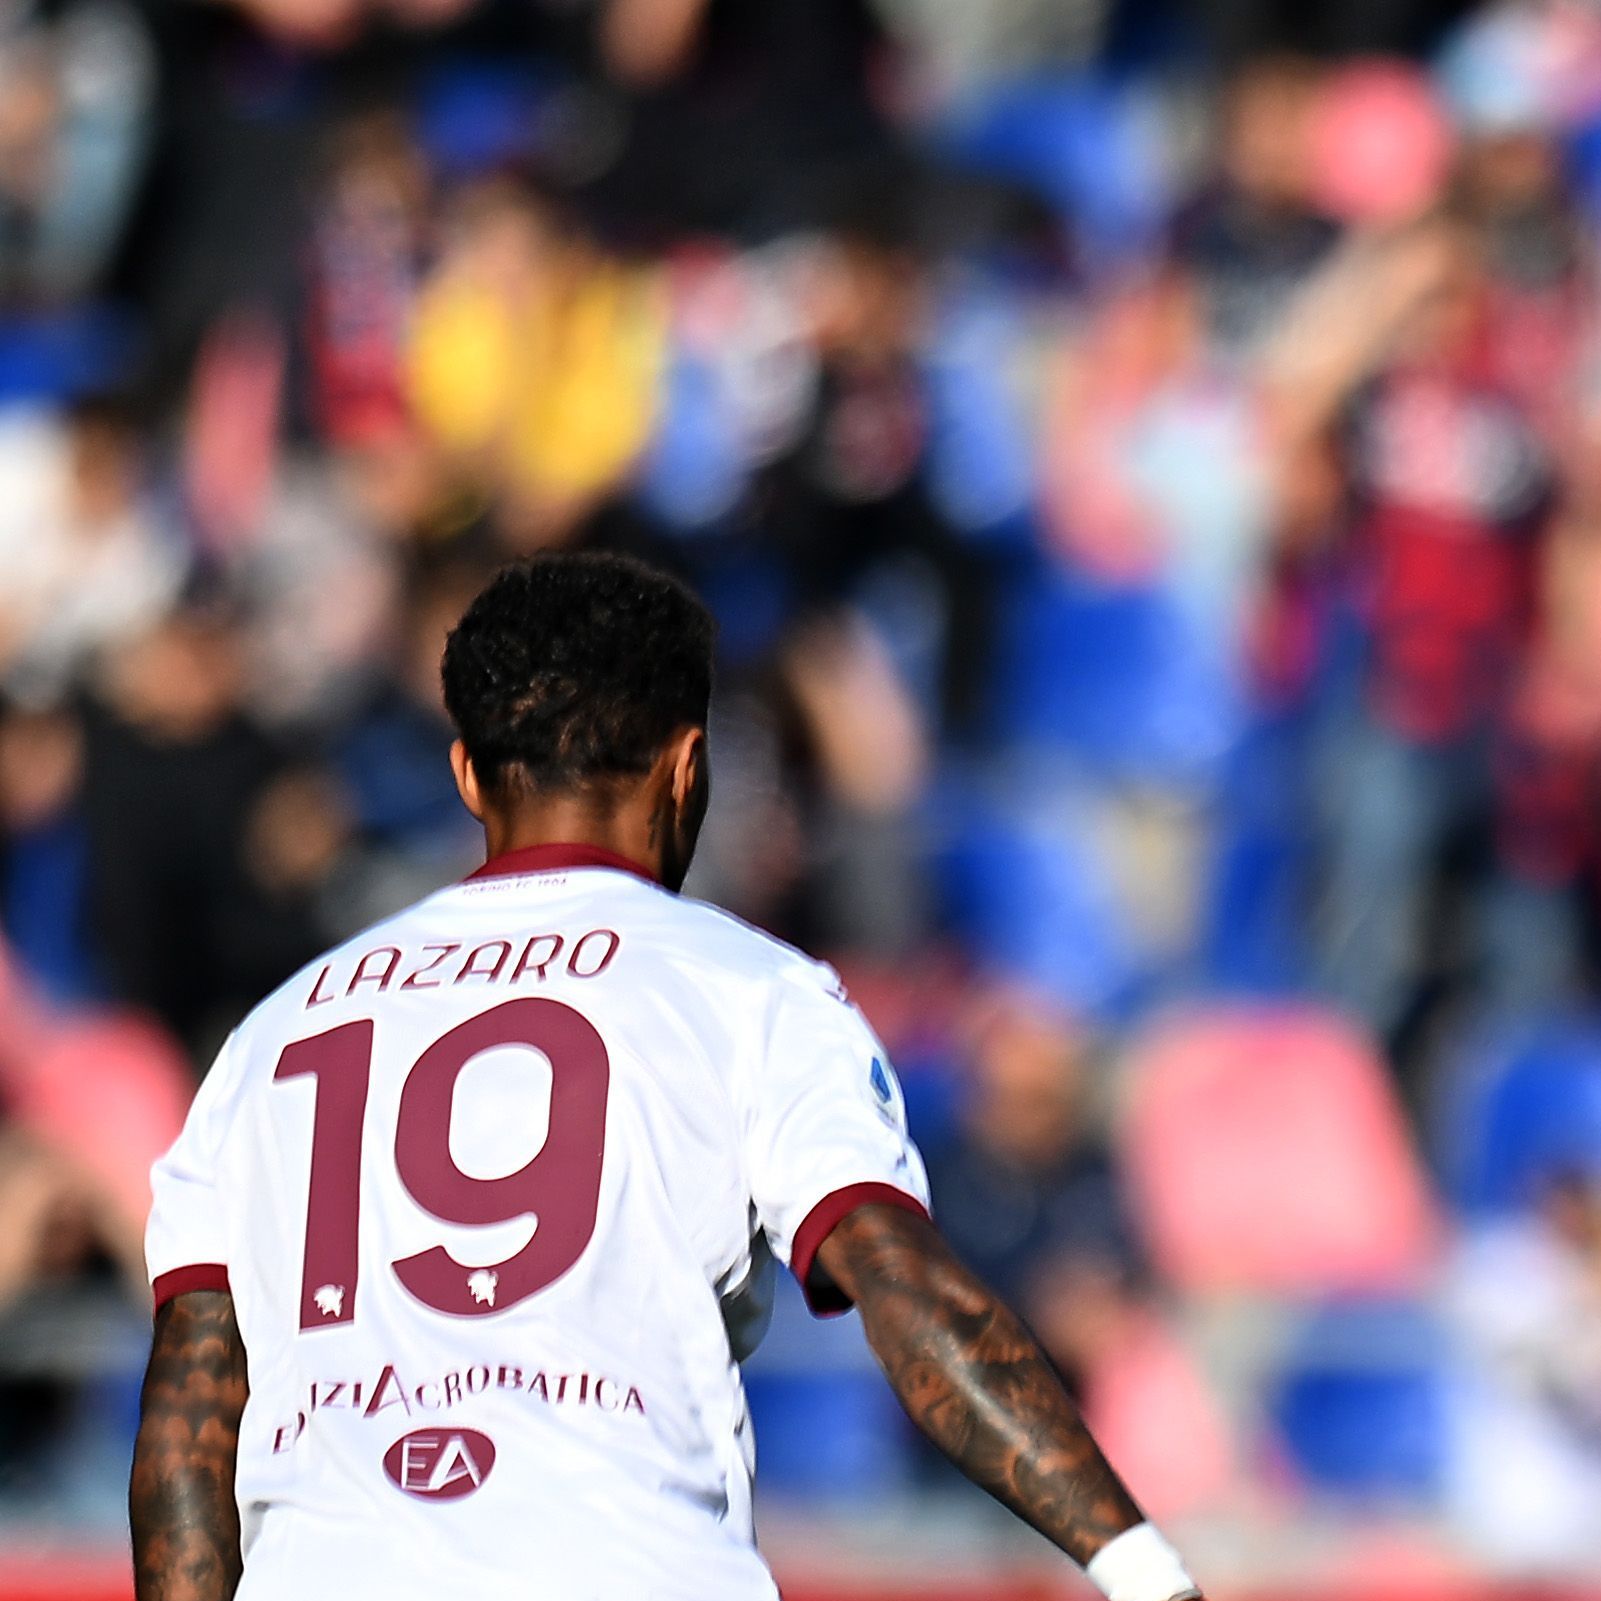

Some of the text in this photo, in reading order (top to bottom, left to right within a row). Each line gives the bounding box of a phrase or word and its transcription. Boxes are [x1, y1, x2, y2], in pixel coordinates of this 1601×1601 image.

[305, 928, 620, 1010] LAZARO
[272, 996, 611, 1335] 19
[398, 1433, 484, 1493] EA
